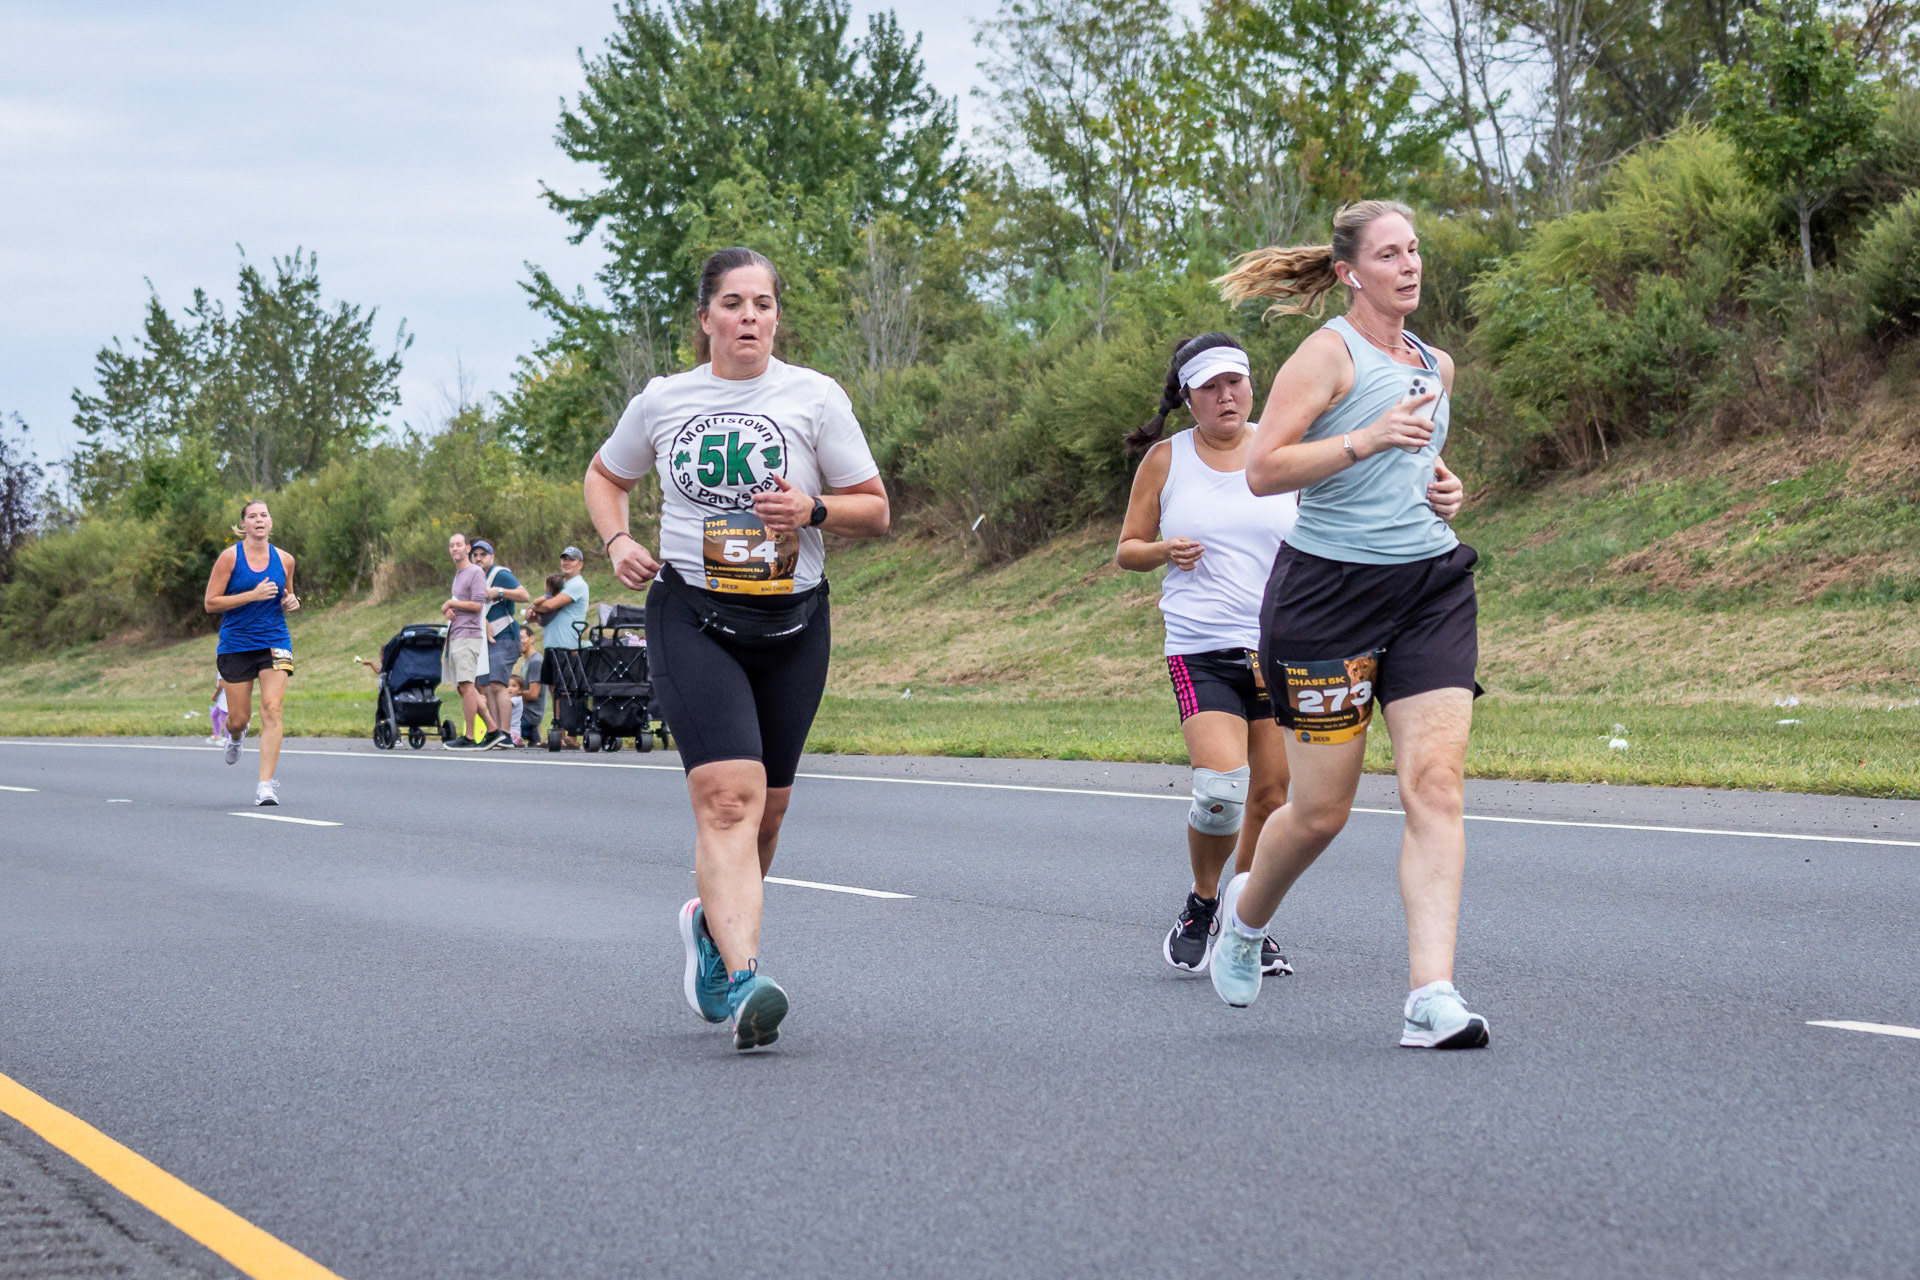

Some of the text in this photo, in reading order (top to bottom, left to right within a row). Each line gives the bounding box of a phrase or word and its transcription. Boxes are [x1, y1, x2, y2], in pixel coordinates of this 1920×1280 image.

[680, 417, 773, 445] Morristown
[679, 472, 693, 494] St.
[705, 519, 728, 529] THE
[705, 528, 762, 537] CHASE 5K
[723, 539, 778, 563] 54
[1286, 668, 1308, 676] THE
[1288, 676, 1345, 686] CHASE 5K
[1297, 680, 1372, 713] 273
